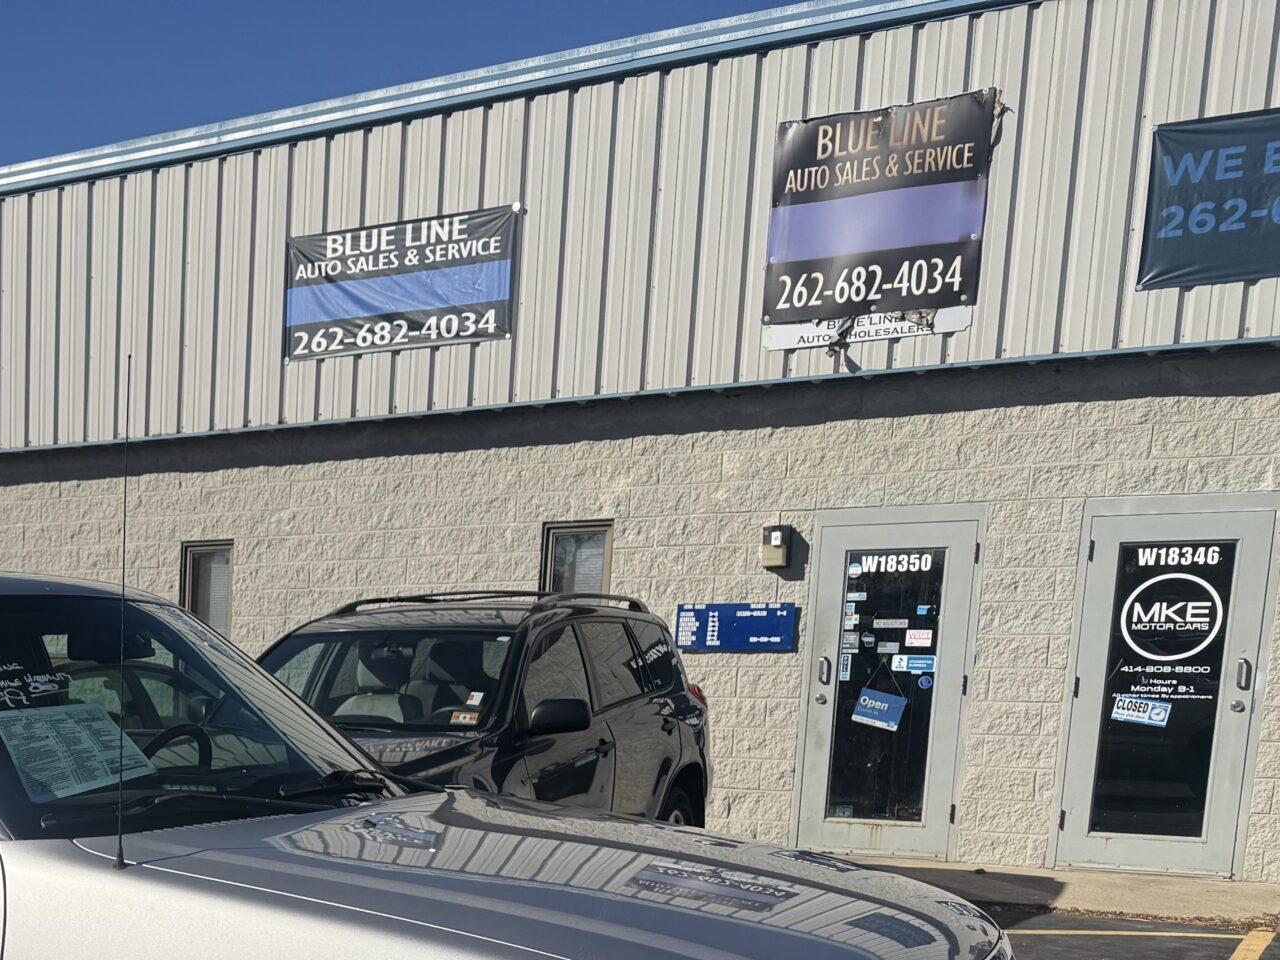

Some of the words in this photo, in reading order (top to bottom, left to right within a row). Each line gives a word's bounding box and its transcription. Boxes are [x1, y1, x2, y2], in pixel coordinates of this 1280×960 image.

[816, 115, 879, 161] BLUE
[888, 105, 948, 148] LINE
[784, 165, 830, 194] AUTO
[834, 155, 881, 187] SALES
[885, 154, 898, 178] &
[903, 142, 975, 176] SERVICE
[1162, 145, 1247, 186] WE
[325, 225, 396, 260] BLUE
[405, 215, 469, 248] LINE
[295, 260, 342, 281] AUTO
[346, 251, 399, 274] SALES
[404, 248, 420, 266] &
[424, 236, 502, 264] SERVICE
[775, 255, 963, 310] 262-682-4034
[292, 308, 497, 356] 262-682-4034
[827, 317, 866, 330] BE
[797, 333, 832, 345] AUTO
[861, 553, 932, 573] W18350
[1138, 546, 1220, 566] W18346
[1132, 601, 1212, 623] MKE
[1131, 623, 1174, 631] MOTOR
[1175, 623, 1210, 631] CARS
[1120, 665, 1211, 673] 414-808-8800
[1130, 685, 1174, 693] Monday
[1177, 685, 1195, 693] 9-1
[860, 695, 889, 711] Open
[1116, 698, 1150, 713] CLOSED
